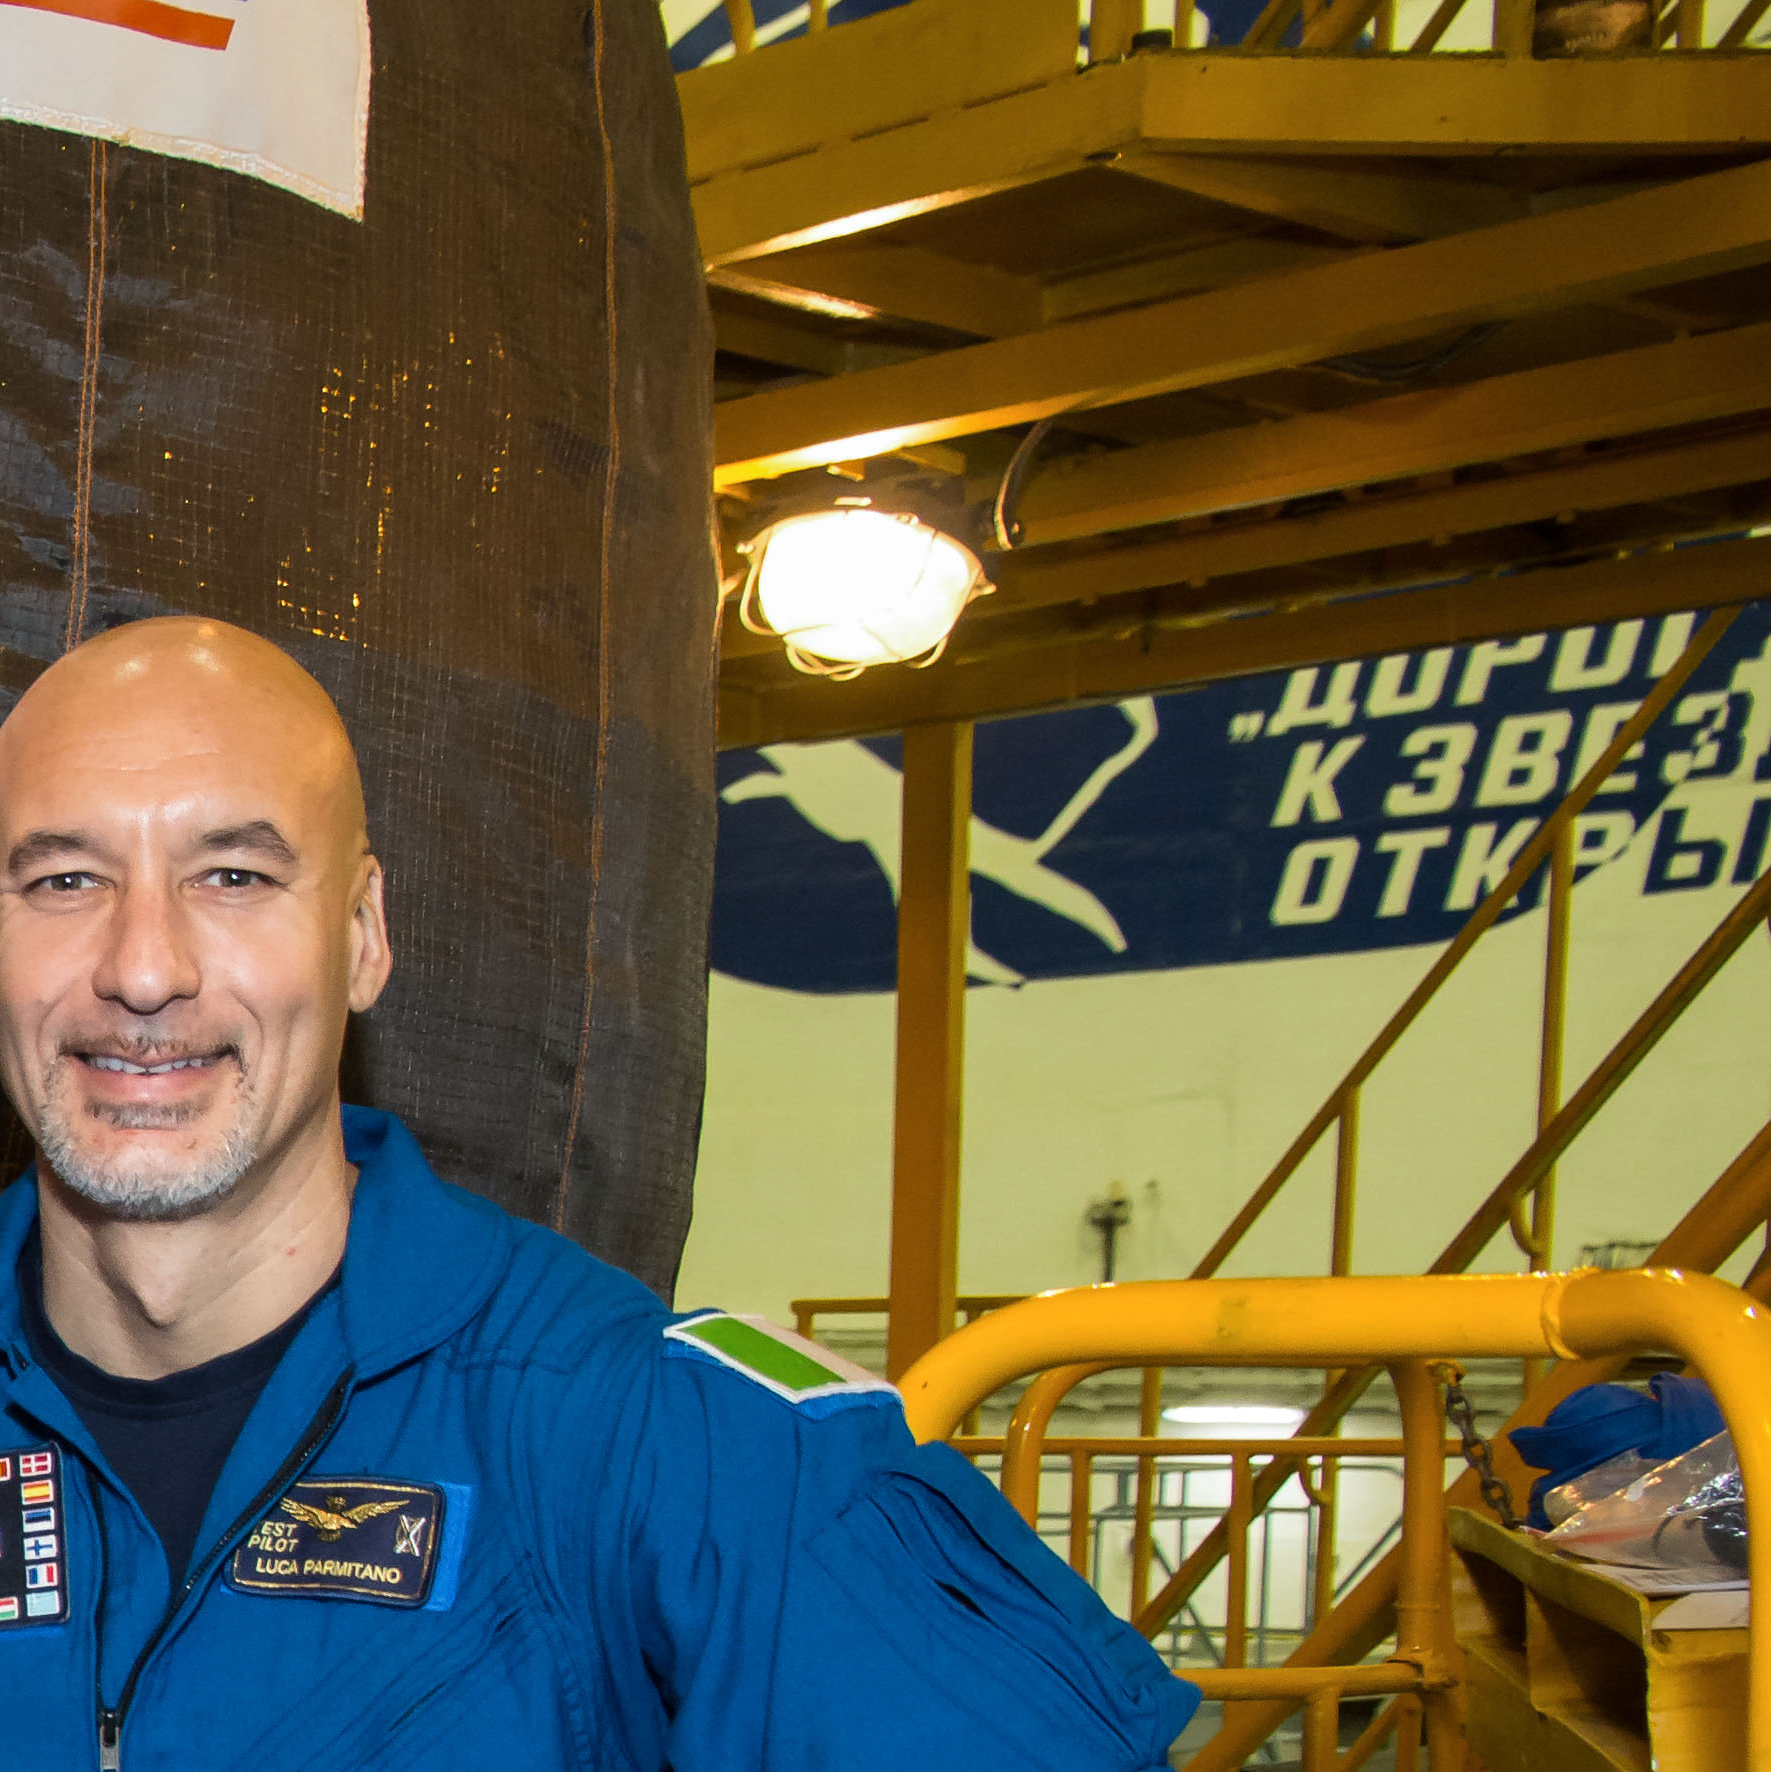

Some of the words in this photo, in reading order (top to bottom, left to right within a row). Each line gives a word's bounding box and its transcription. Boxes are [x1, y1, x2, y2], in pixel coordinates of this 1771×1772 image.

[1270, 735, 1365, 828] К
[1382, 690, 1771, 818] ЗВЕЗ
[254, 1520, 299, 1538] EST
[247, 1535, 300, 1553] PILOT
[256, 1557, 298, 1575] LUCA
[303, 1559, 401, 1584] PARMITANO
